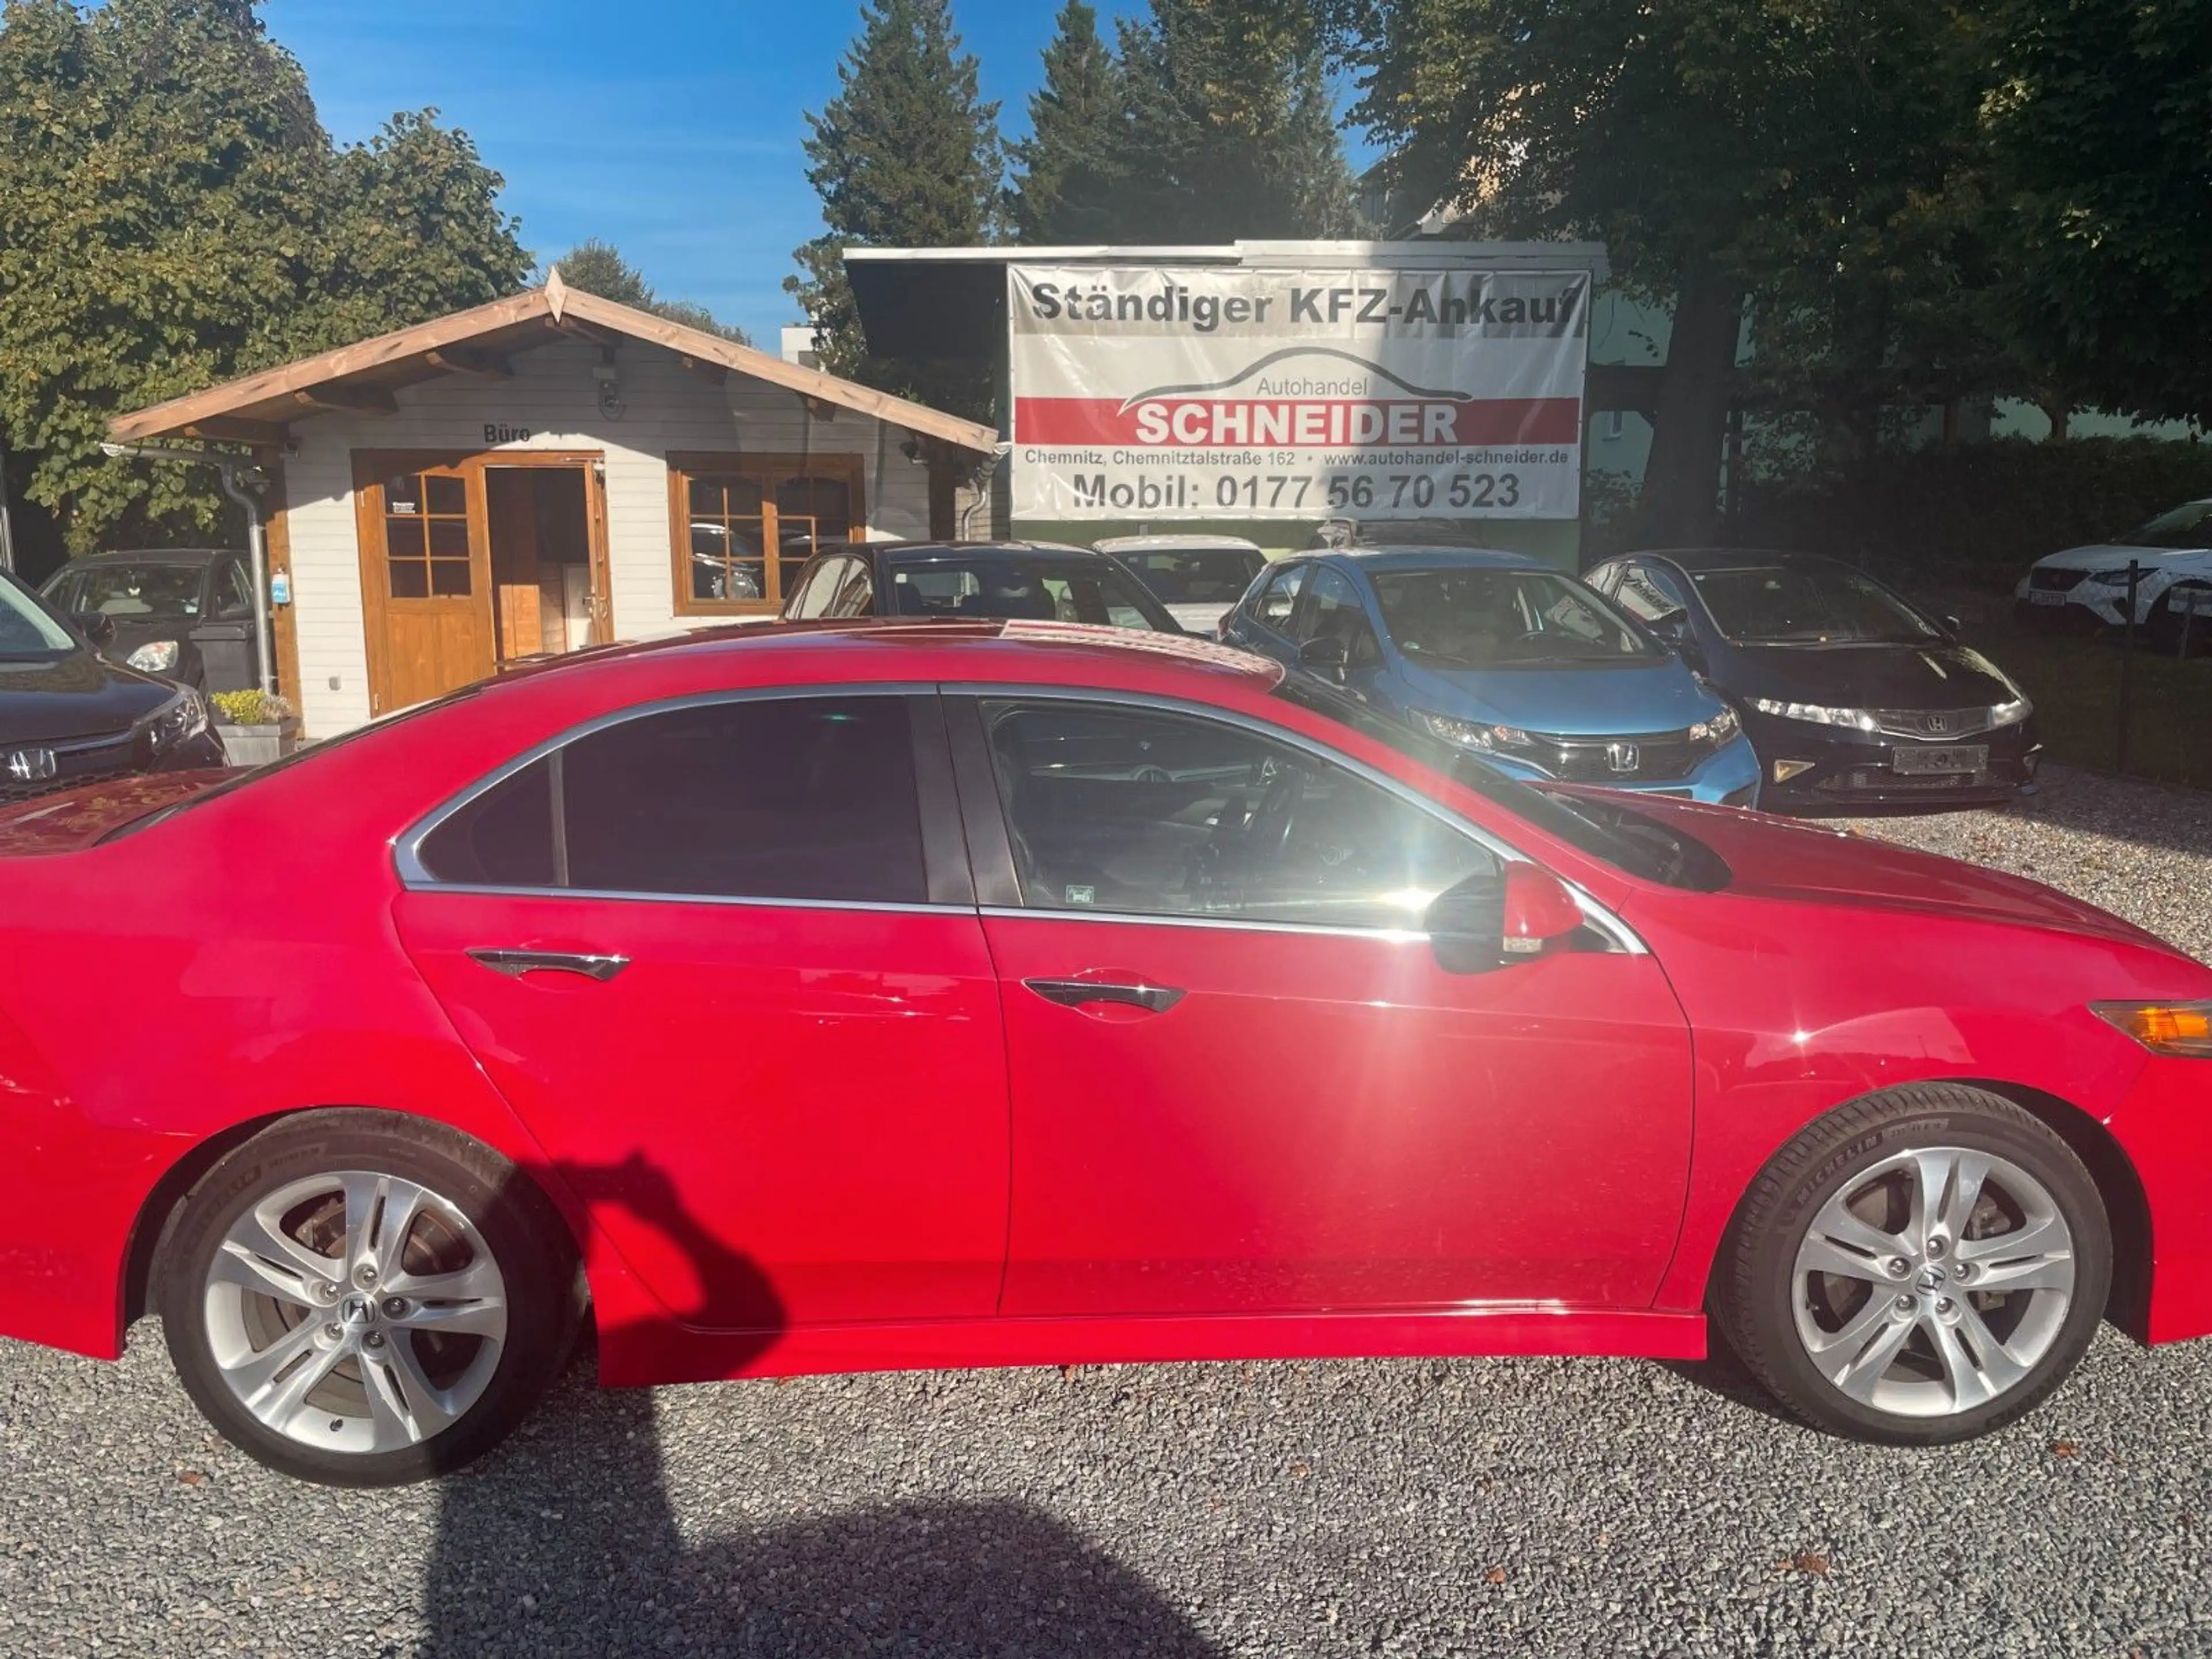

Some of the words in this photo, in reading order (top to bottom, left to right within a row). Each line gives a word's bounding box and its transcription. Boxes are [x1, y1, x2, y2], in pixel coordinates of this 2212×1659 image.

[1032, 283, 1272, 332] Ständiger
[1290, 287, 1583, 325] KFZ-Ankauf
[1256, 377, 1368, 396] Autohandel
[484, 423, 531, 444] Büro
[1135, 403, 1459, 445] SCHNEIDER
[1025, 449, 1107, 467] Chemnitz,
[1112, 450, 1262, 466] Chemnitztalstraße
[1268, 452, 1295, 465] 162
[1324, 449, 1569, 465] www.autohandel-schneider.de
[1073, 474, 1199, 509] Mobil:
[1216, 475, 1313, 509] 0177
[1327, 474, 1374, 509] 56
[1389, 474, 1434, 509] 70
[1448, 473, 1520, 509] 523
